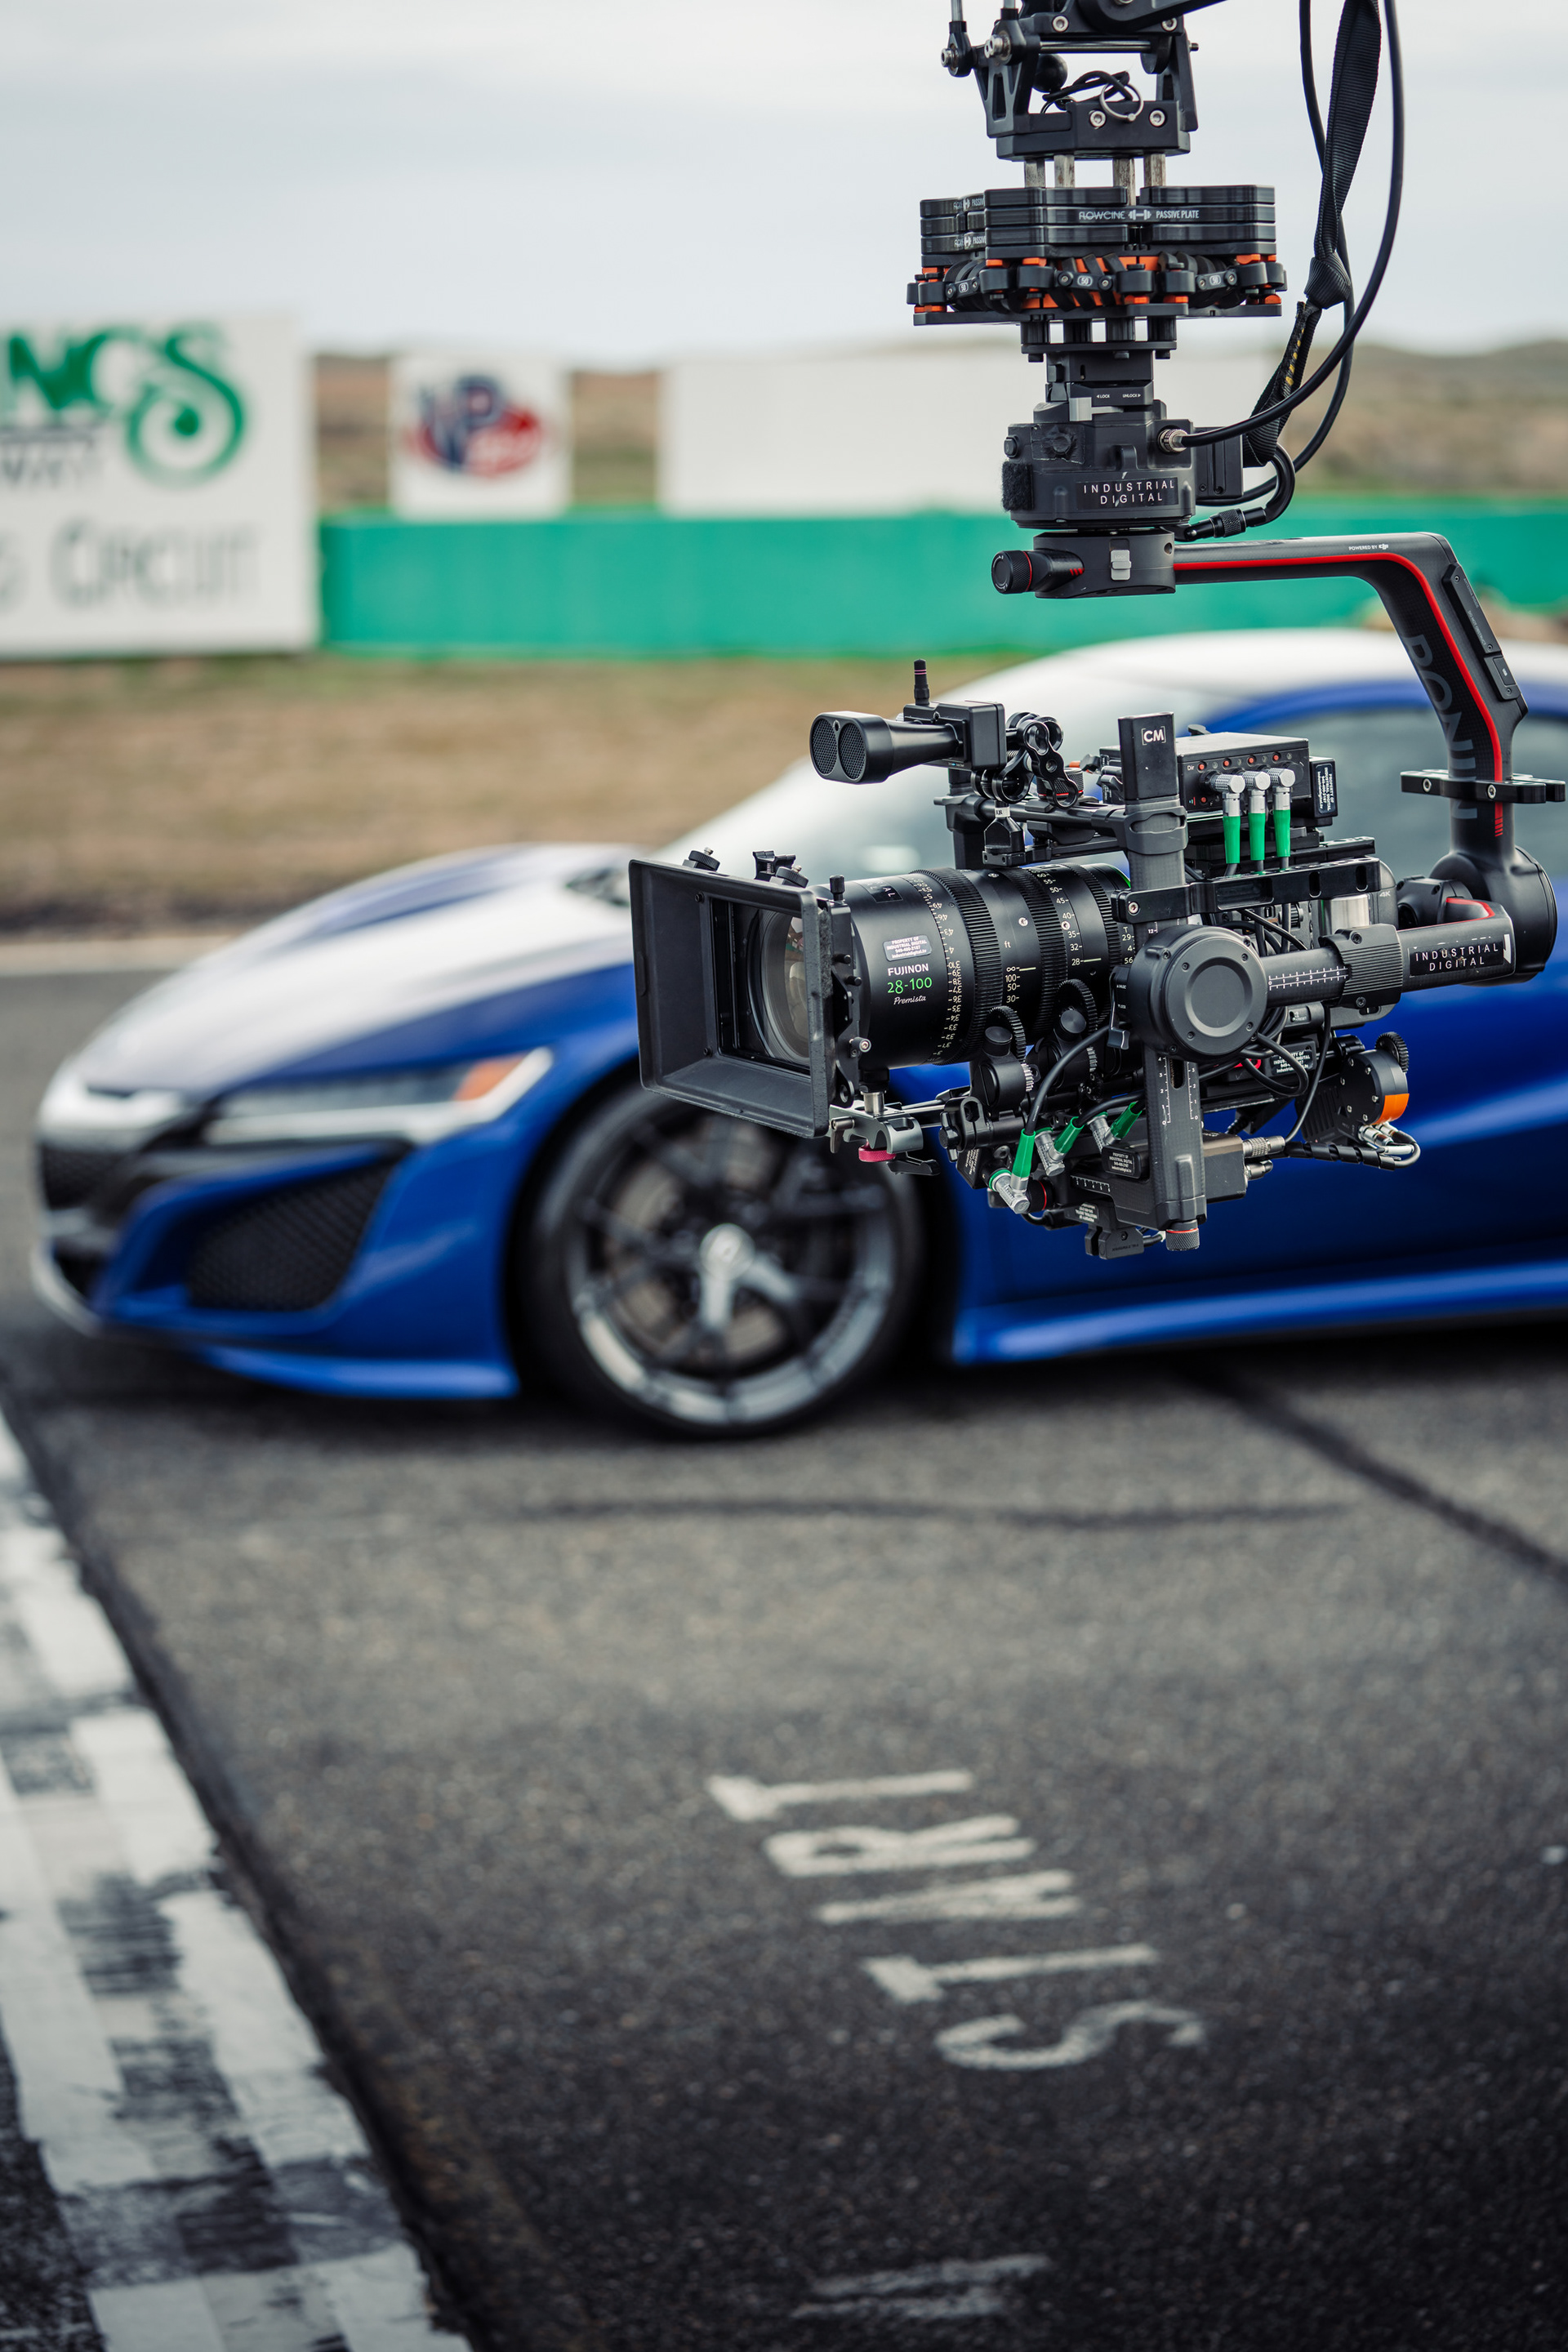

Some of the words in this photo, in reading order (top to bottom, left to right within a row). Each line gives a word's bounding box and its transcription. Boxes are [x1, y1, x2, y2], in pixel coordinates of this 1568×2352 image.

[1079, 211, 1125, 220] FLOWCINE
[1156, 210, 1181, 219] PASSIVE
[1181, 210, 1200, 219] PLATE
[1084, 479, 1174, 494] INDUSTRIAL
[1101, 492, 1163, 505] DIGITAL
[1070, 943, 1079, 951] 32
[1416, 943, 1499, 962] INDUSTRIAL
[1071, 958, 1080, 966] 28
[1429, 956, 1485, 972] DIGITAL
[888, 963, 929, 977] FUJINON
[1004, 973, 1017, 983] 100
[887, 977, 933, 994] 28-100
[1007, 983, 1017, 991] 50
[893, 995, 927, 1005] Premista
[1006, 995, 1016, 1004] 30
[704, 1767, 1209, 2071] START
